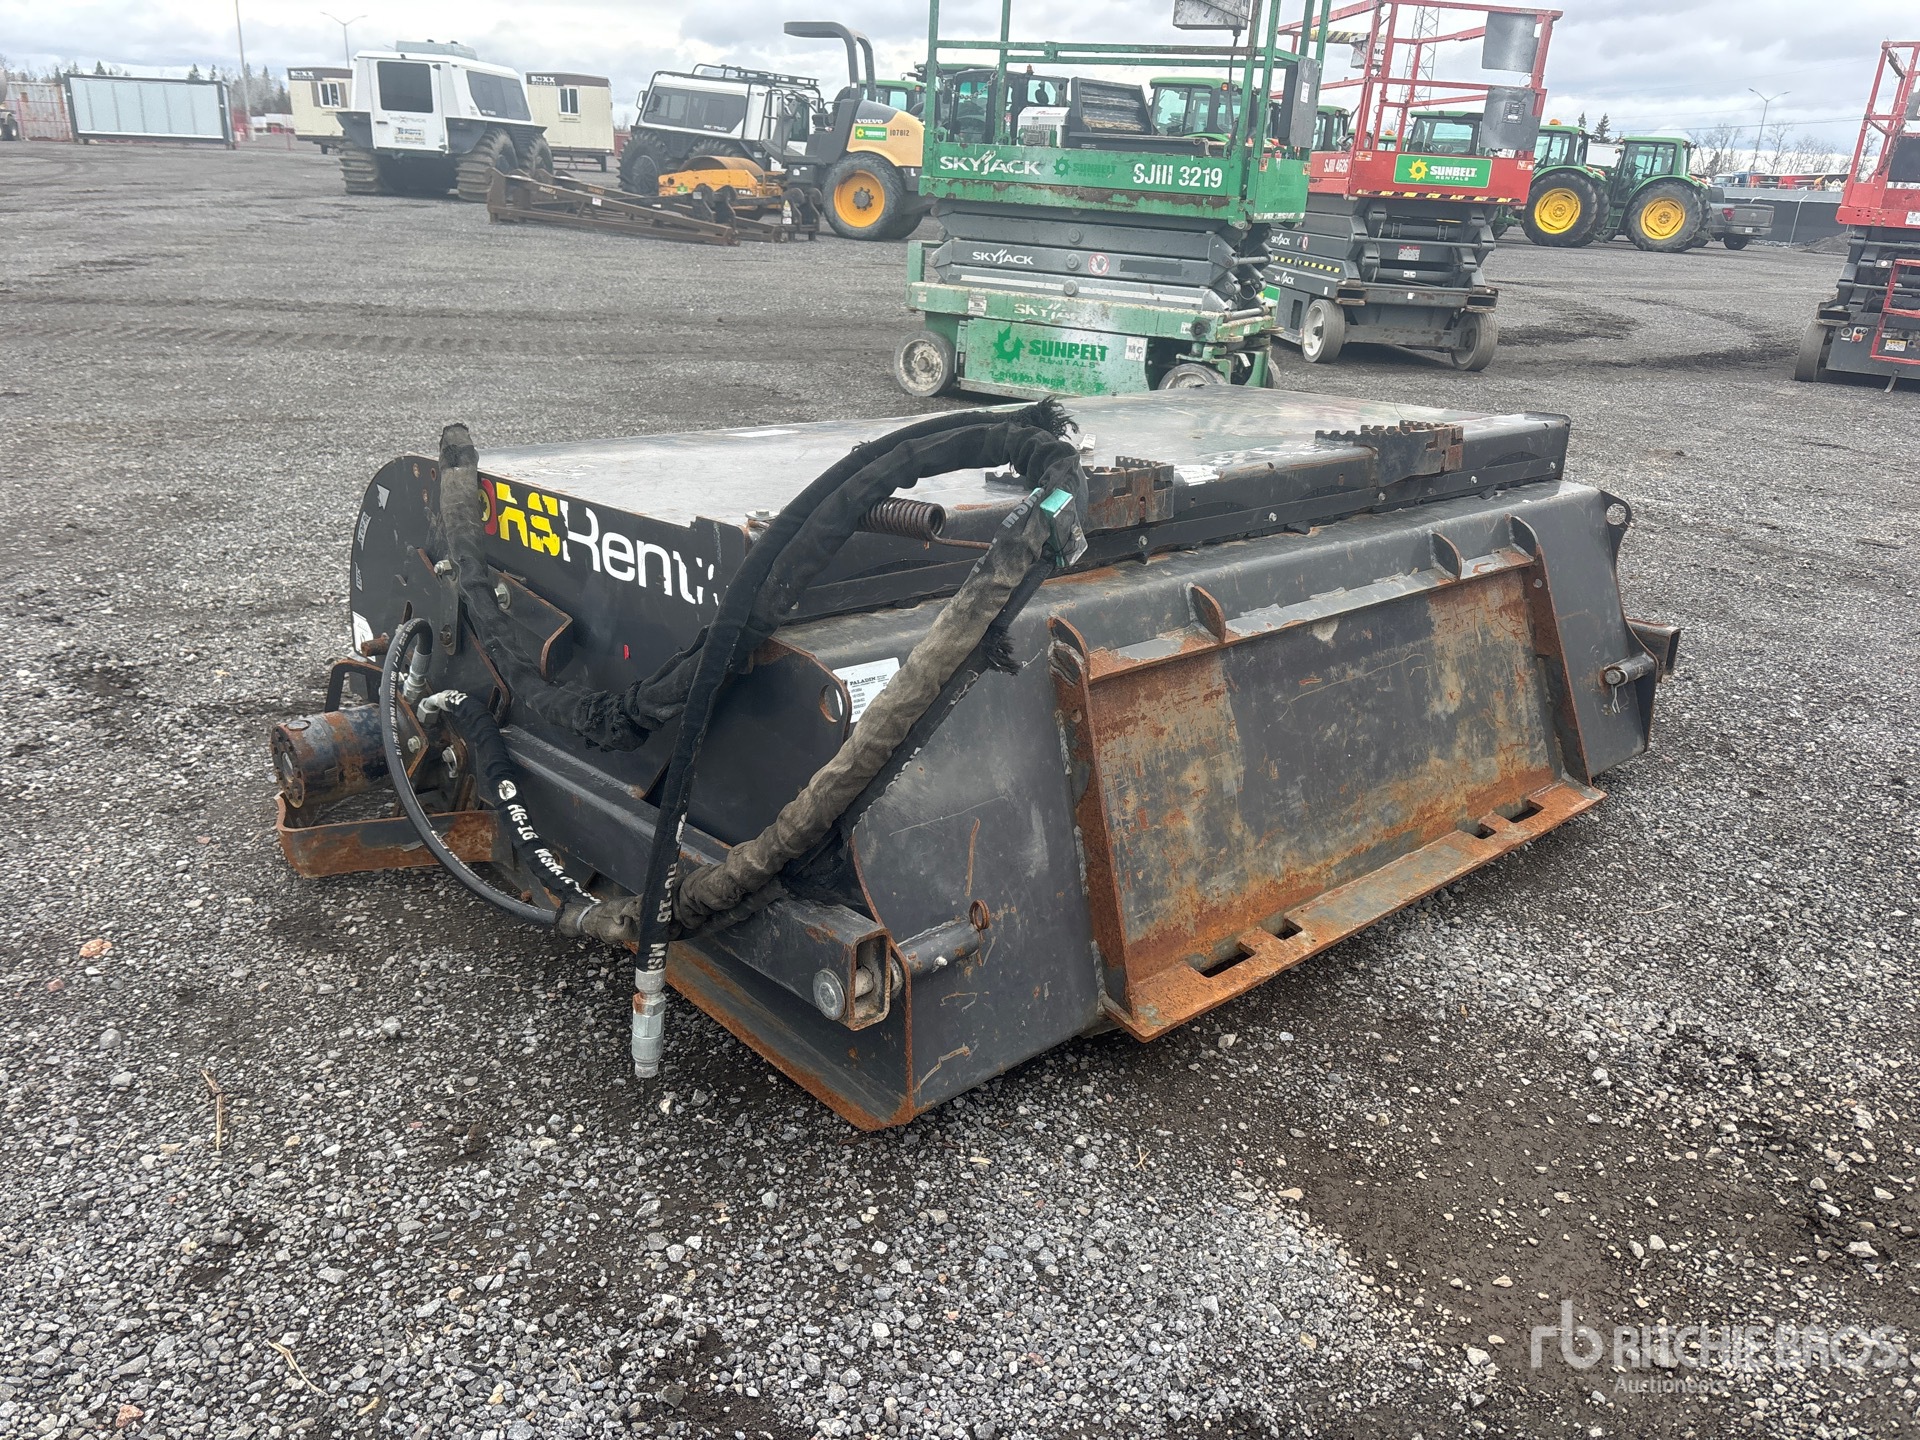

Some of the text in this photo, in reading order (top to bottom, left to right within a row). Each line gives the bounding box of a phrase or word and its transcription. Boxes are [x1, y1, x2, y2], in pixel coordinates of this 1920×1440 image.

[940, 149, 1042, 176] SKYJACK
[1178, 165, 1223, 188] 3219
[971, 248, 1035, 266] SKYJACK
[507, 804, 540, 841] HG-16
